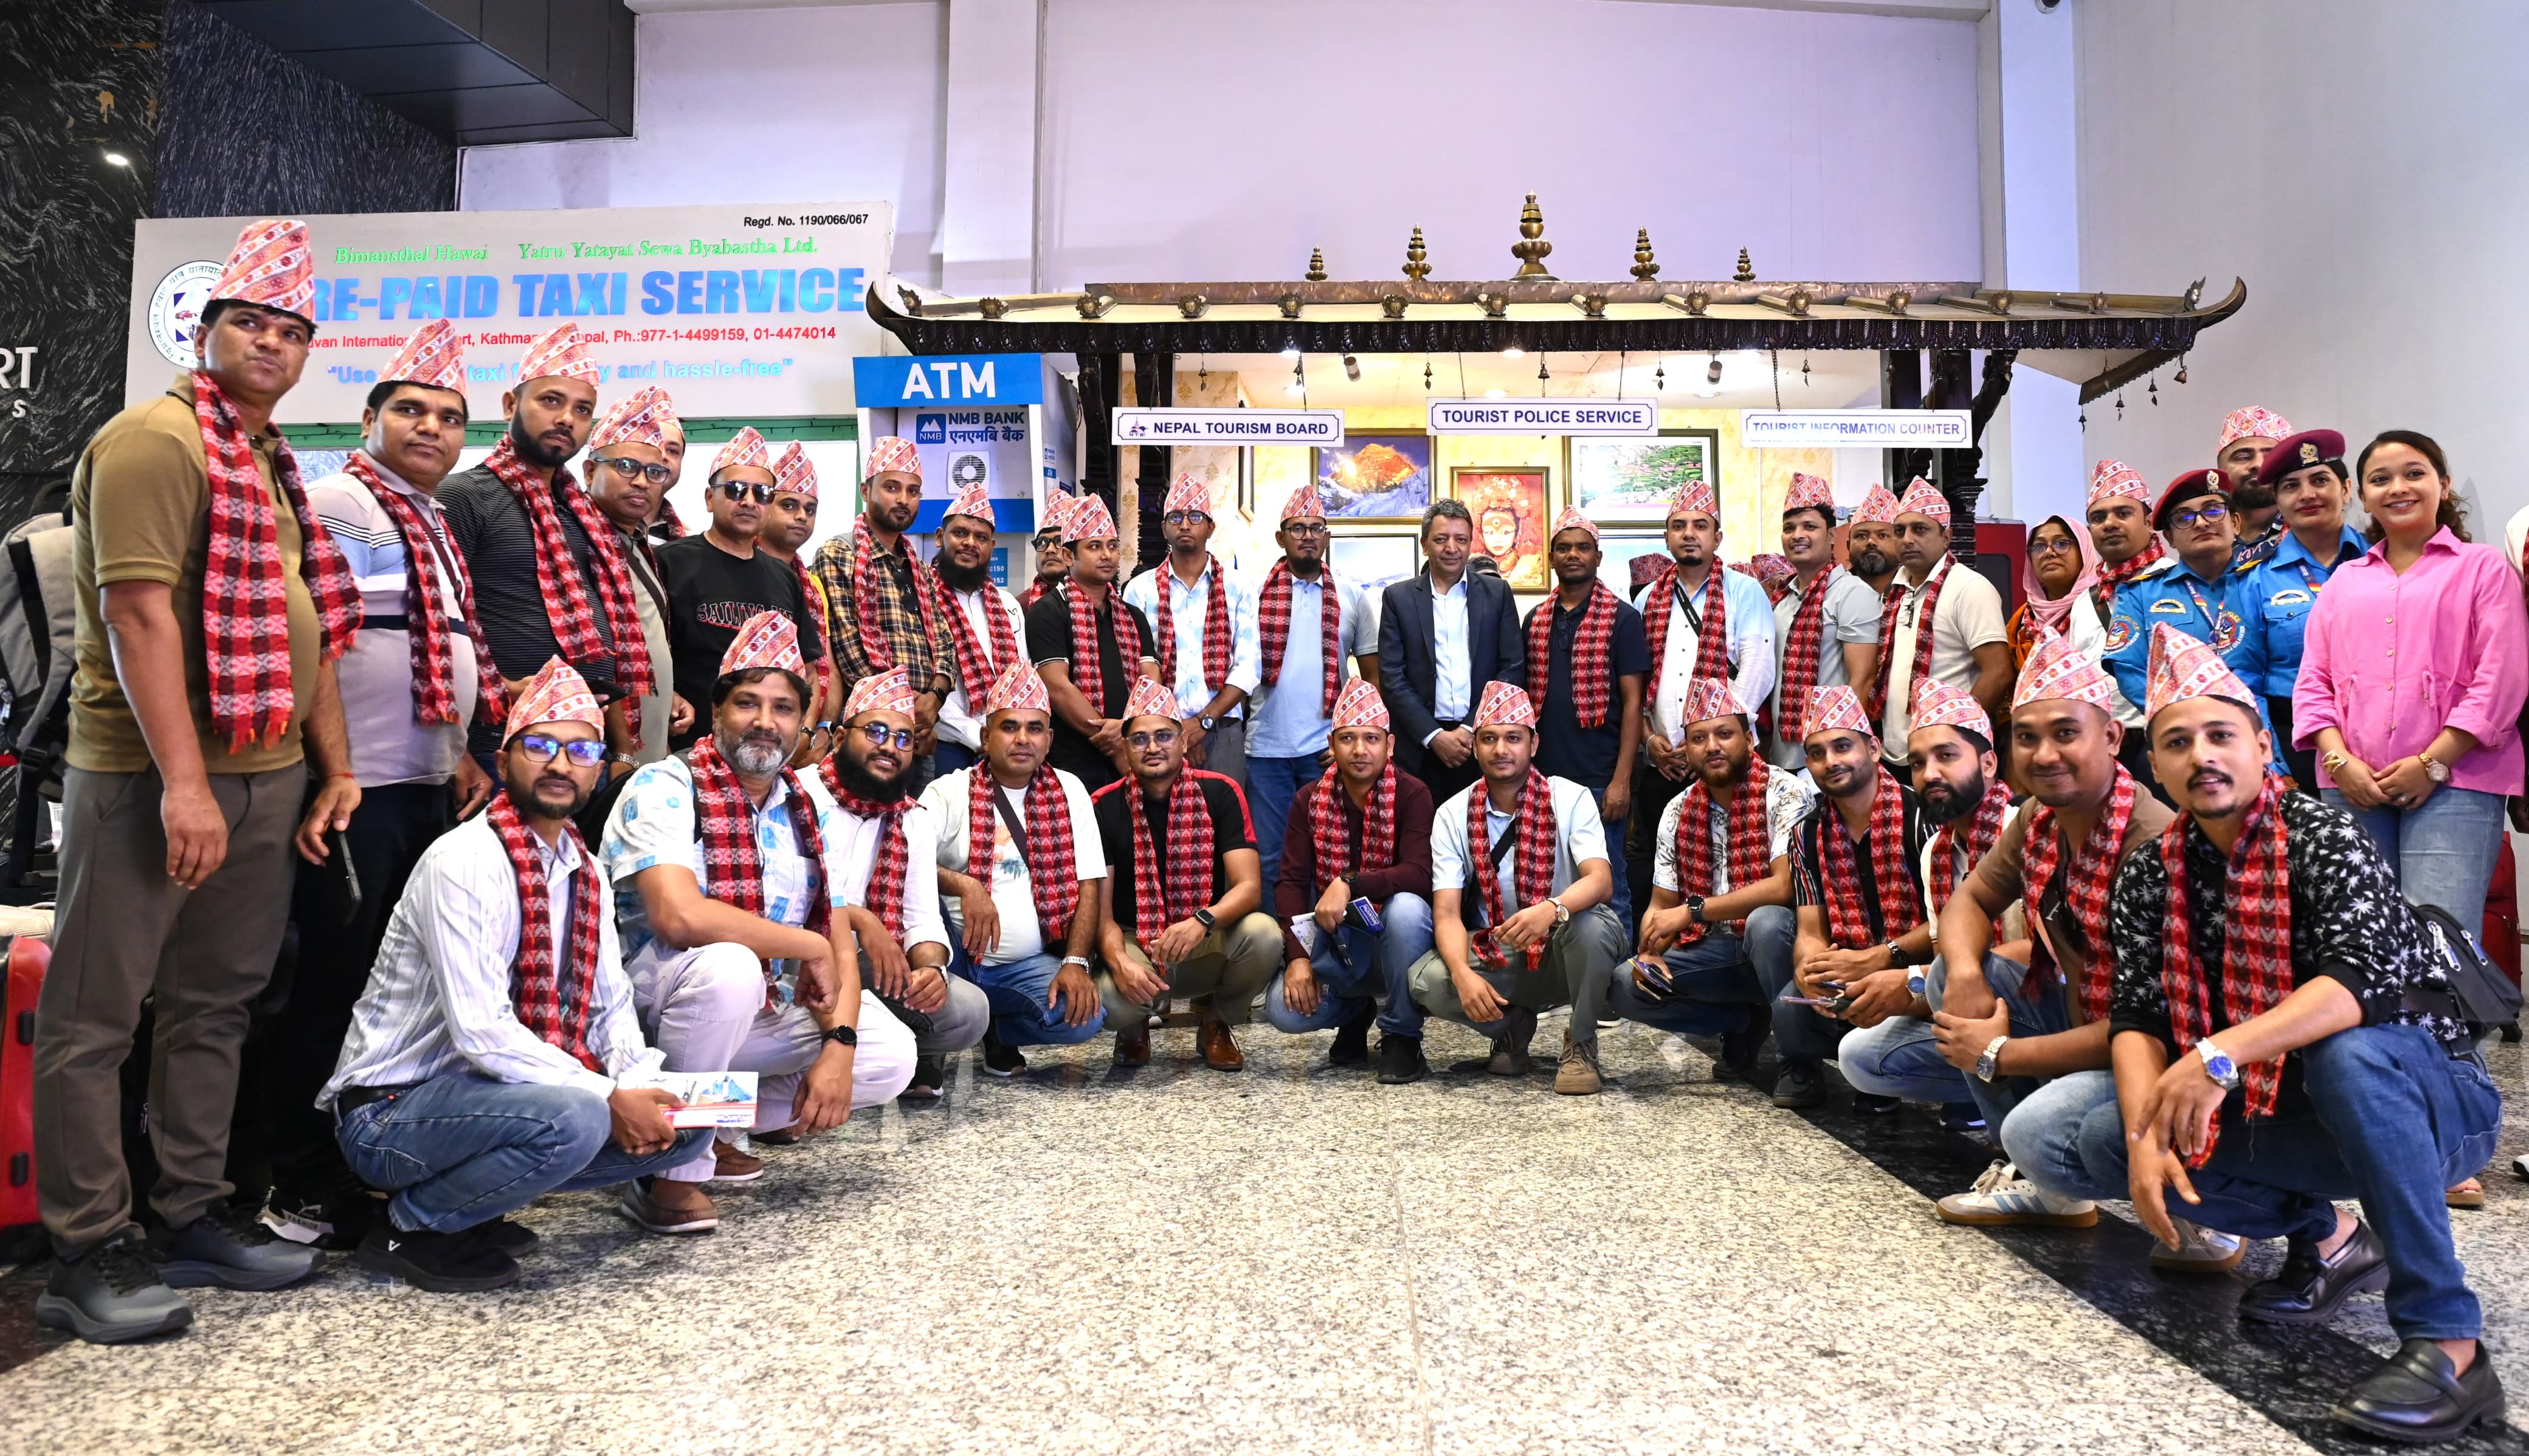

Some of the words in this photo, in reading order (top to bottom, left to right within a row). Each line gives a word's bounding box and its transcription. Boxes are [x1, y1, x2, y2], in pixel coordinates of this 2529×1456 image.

[744, 216, 773, 229] Regd.
[778, 216, 795, 226] No.
[799, 214, 868, 225] 1190/066/067
[336, 246, 429, 263] Bimansthal
[518, 243, 565, 260] Yatru
[573, 242, 633, 260] Yatayat
[639, 240, 683, 257] Sewa
[688, 238, 778, 258] Byabastha
[783, 236, 819, 254] Ltd.
[314, 275, 499, 321] RE-PAID
[513, 272, 627, 317] TAXI
[641, 267, 864, 316] SERVICE
[342, 335, 408, 348] Internatio
[481, 332, 537, 345] Kathma
[584, 331, 609, 344] pal,
[614, 328, 749, 342] Ph.:977-1-4499159,
[753, 326, 836, 340] 01-4474014
[468, 363, 505, 382] taxi
[617, 361, 657, 379] and
[664, 359, 793, 378] hassle-free"
[902, 361, 996, 399] ATM
[948, 412, 981, 424] NMB
[984, 412, 1025, 424] BANK
[1443, 410, 1509, 423] TOURIST
[1514, 410, 1570, 423] POLICE
[1576, 410, 1642, 423] SERVICE
[919, 432, 942, 441] NMB
[948, 426, 998, 444] एनएमबि
[1001, 425, 1025, 442] बैंक
[1154, 423, 1201, 433] NEPAL
[1206, 423, 1271, 434] TOURISM
[1276, 423, 1328, 434] BOARD
[1900, 423, 1959, 435] COUNTER
